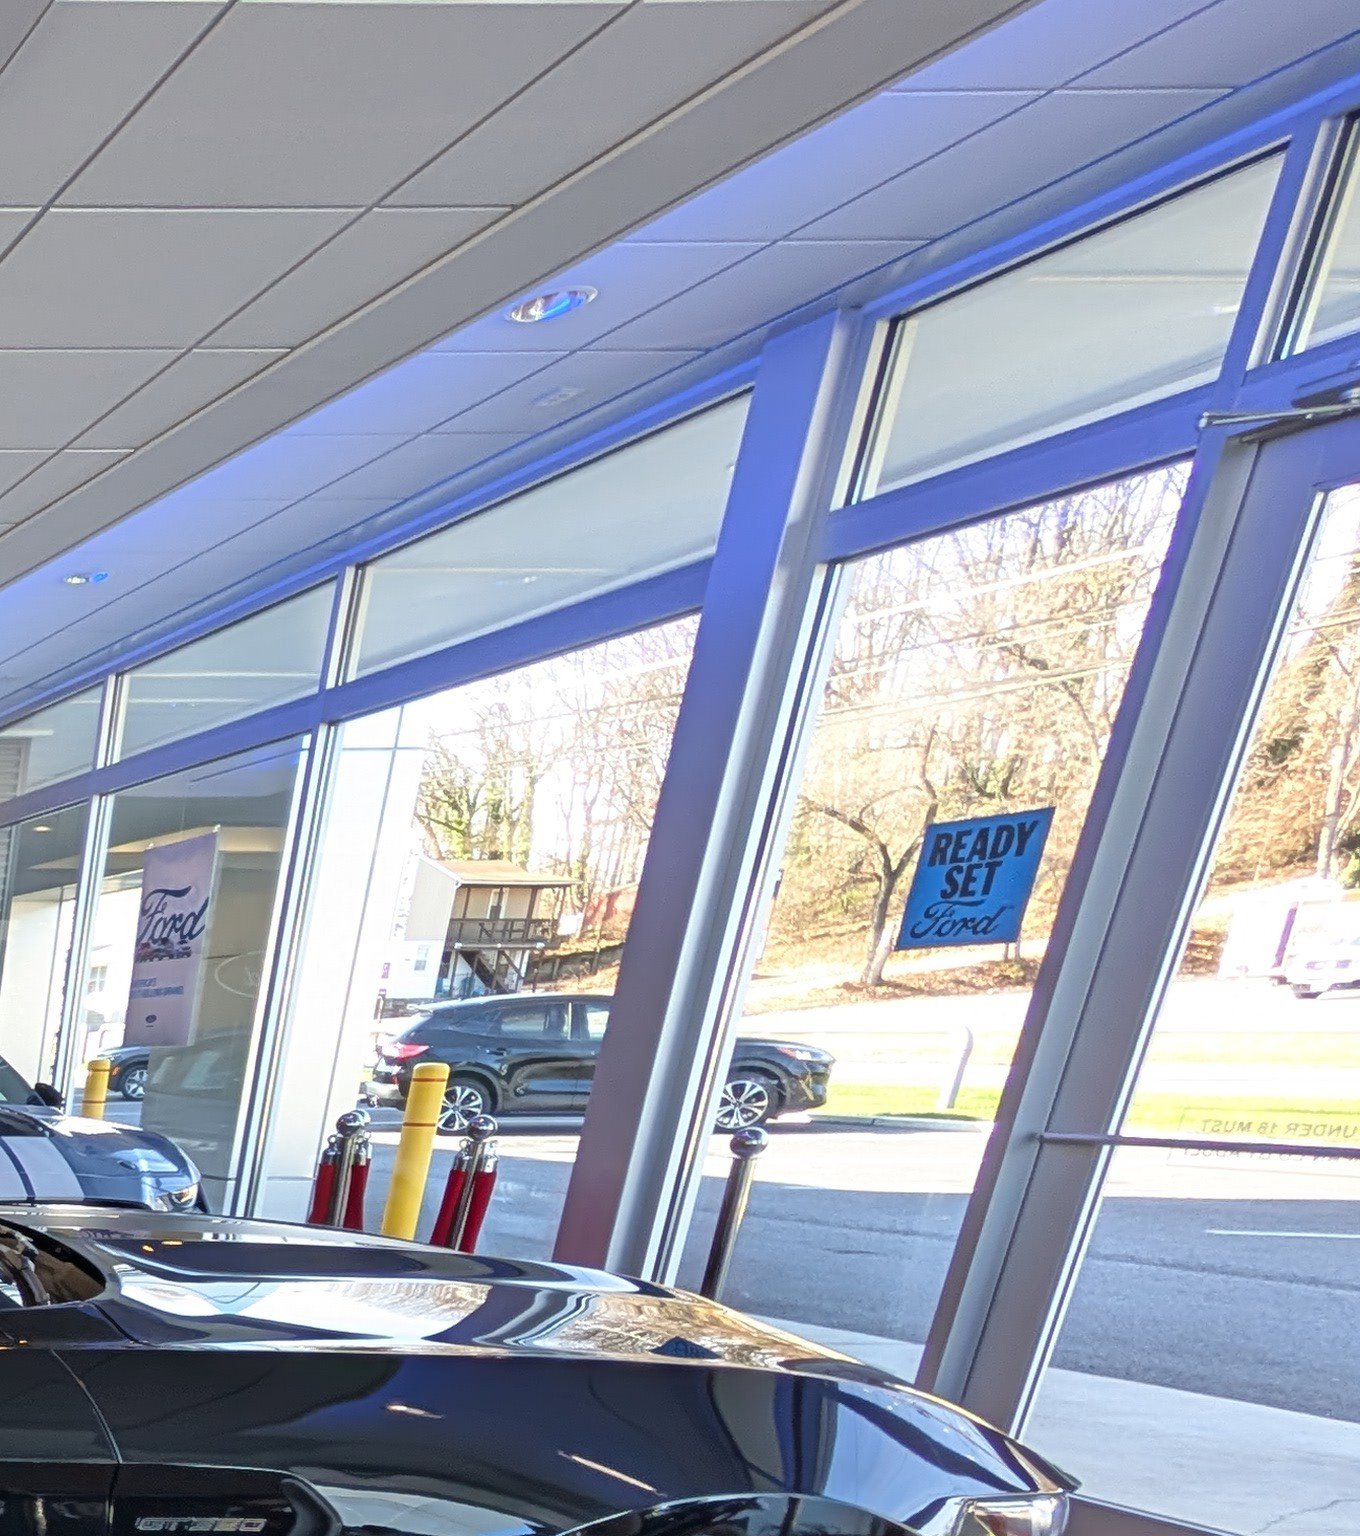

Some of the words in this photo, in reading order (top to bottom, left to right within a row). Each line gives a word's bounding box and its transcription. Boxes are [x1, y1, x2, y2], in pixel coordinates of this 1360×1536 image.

[928, 820, 1041, 867] READY
[940, 860, 1003, 899] SET
[137, 885, 209, 945] Ford
[910, 899, 1008, 939] Ford
